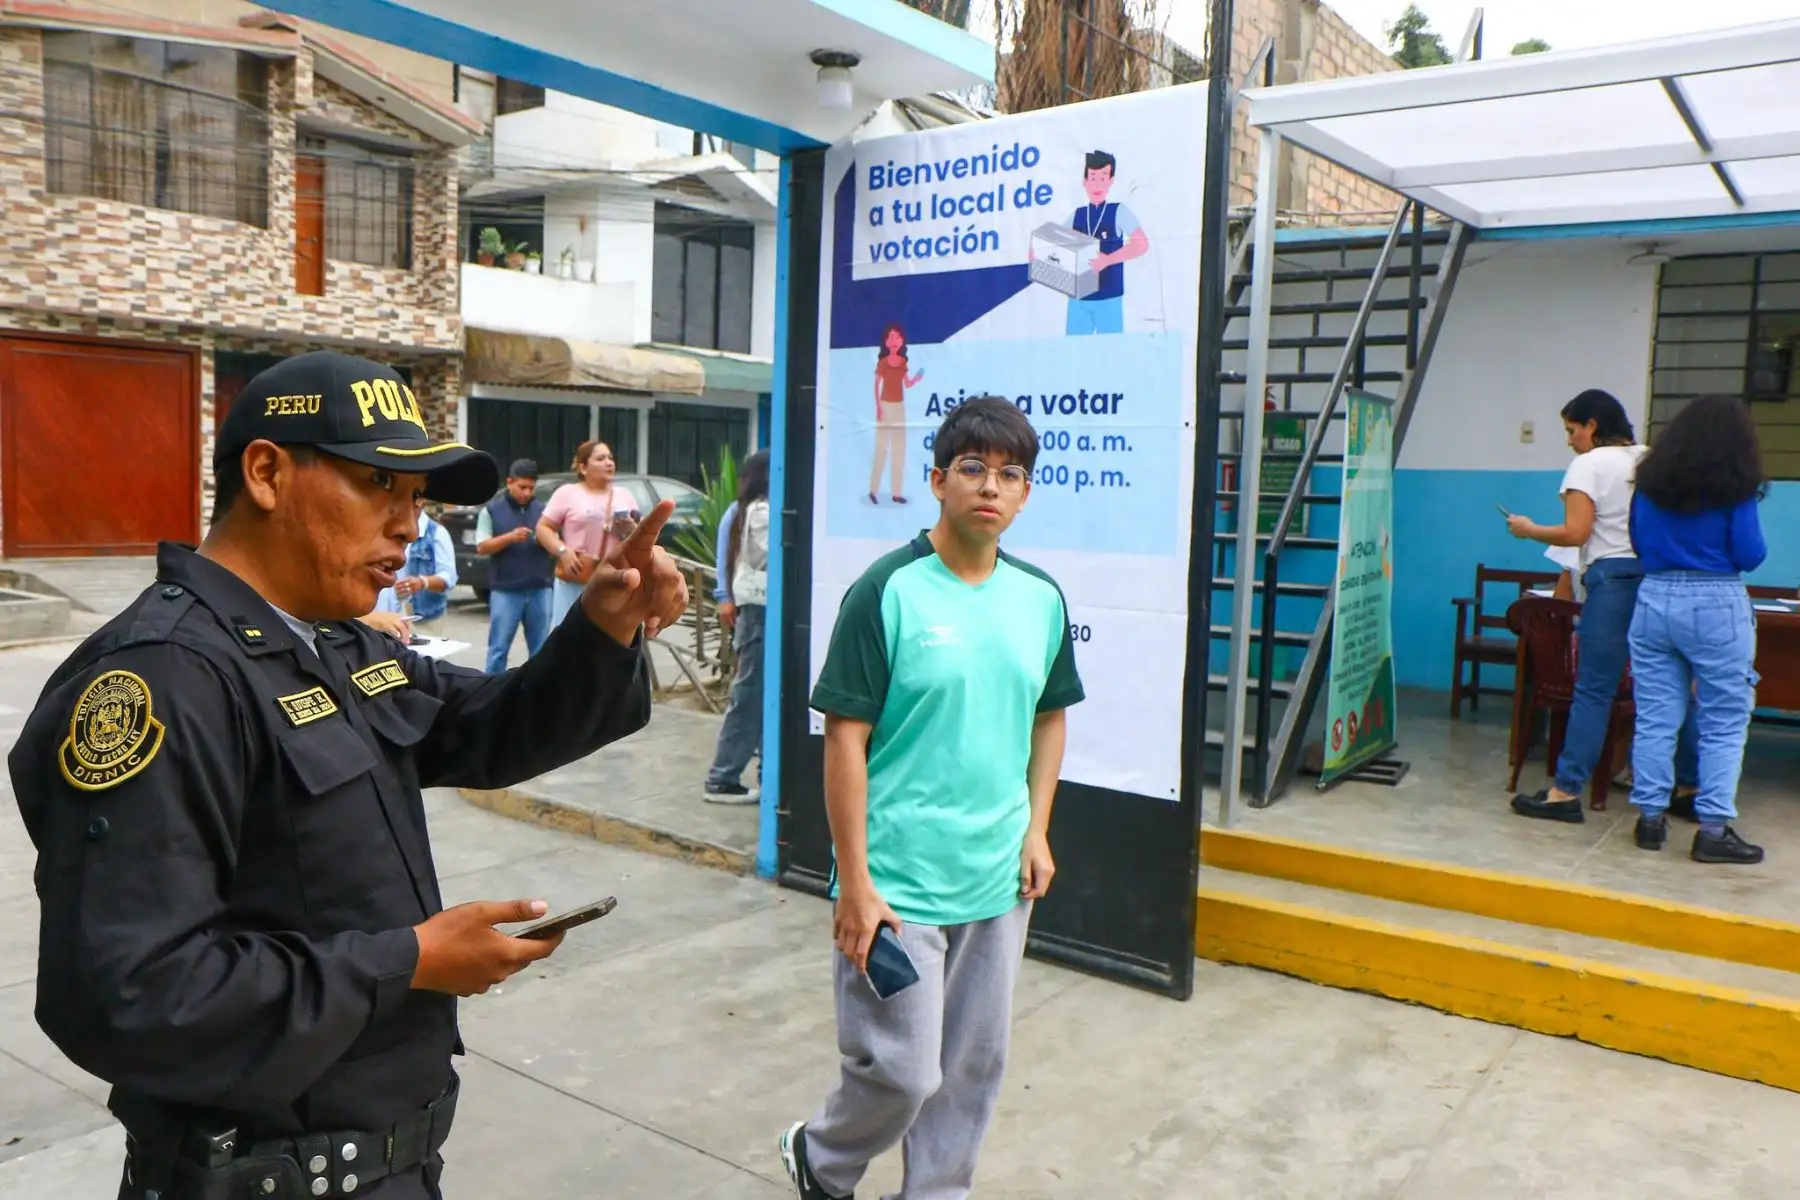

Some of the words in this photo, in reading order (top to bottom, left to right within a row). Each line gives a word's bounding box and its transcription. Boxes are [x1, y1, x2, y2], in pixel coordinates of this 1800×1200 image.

[868, 143, 1040, 191] Bienvenido
[869, 206, 884, 227] a
[892, 200, 922, 223] tu
[931, 184, 1005, 220] local
[1014, 180, 1053, 208] de
[869, 225, 999, 263] votación
[264, 394, 322, 416] PERU
[350, 378, 429, 440] POLI
[1014, 395, 1031, 416] a
[1040, 388, 1124, 416] votar
[1036, 430, 1071, 451] :00
[1103, 435, 1132, 452] m.
[1030, 465, 1069, 486] :00
[1075, 470, 1095, 493] p.
[1101, 470, 1130, 488] m.
[78, 682, 105, 722] POLICIA
[109, 676, 146, 707] NACIONAL
[126, 729, 141, 745] LEY
[73, 754, 141, 783] DIRNIC
